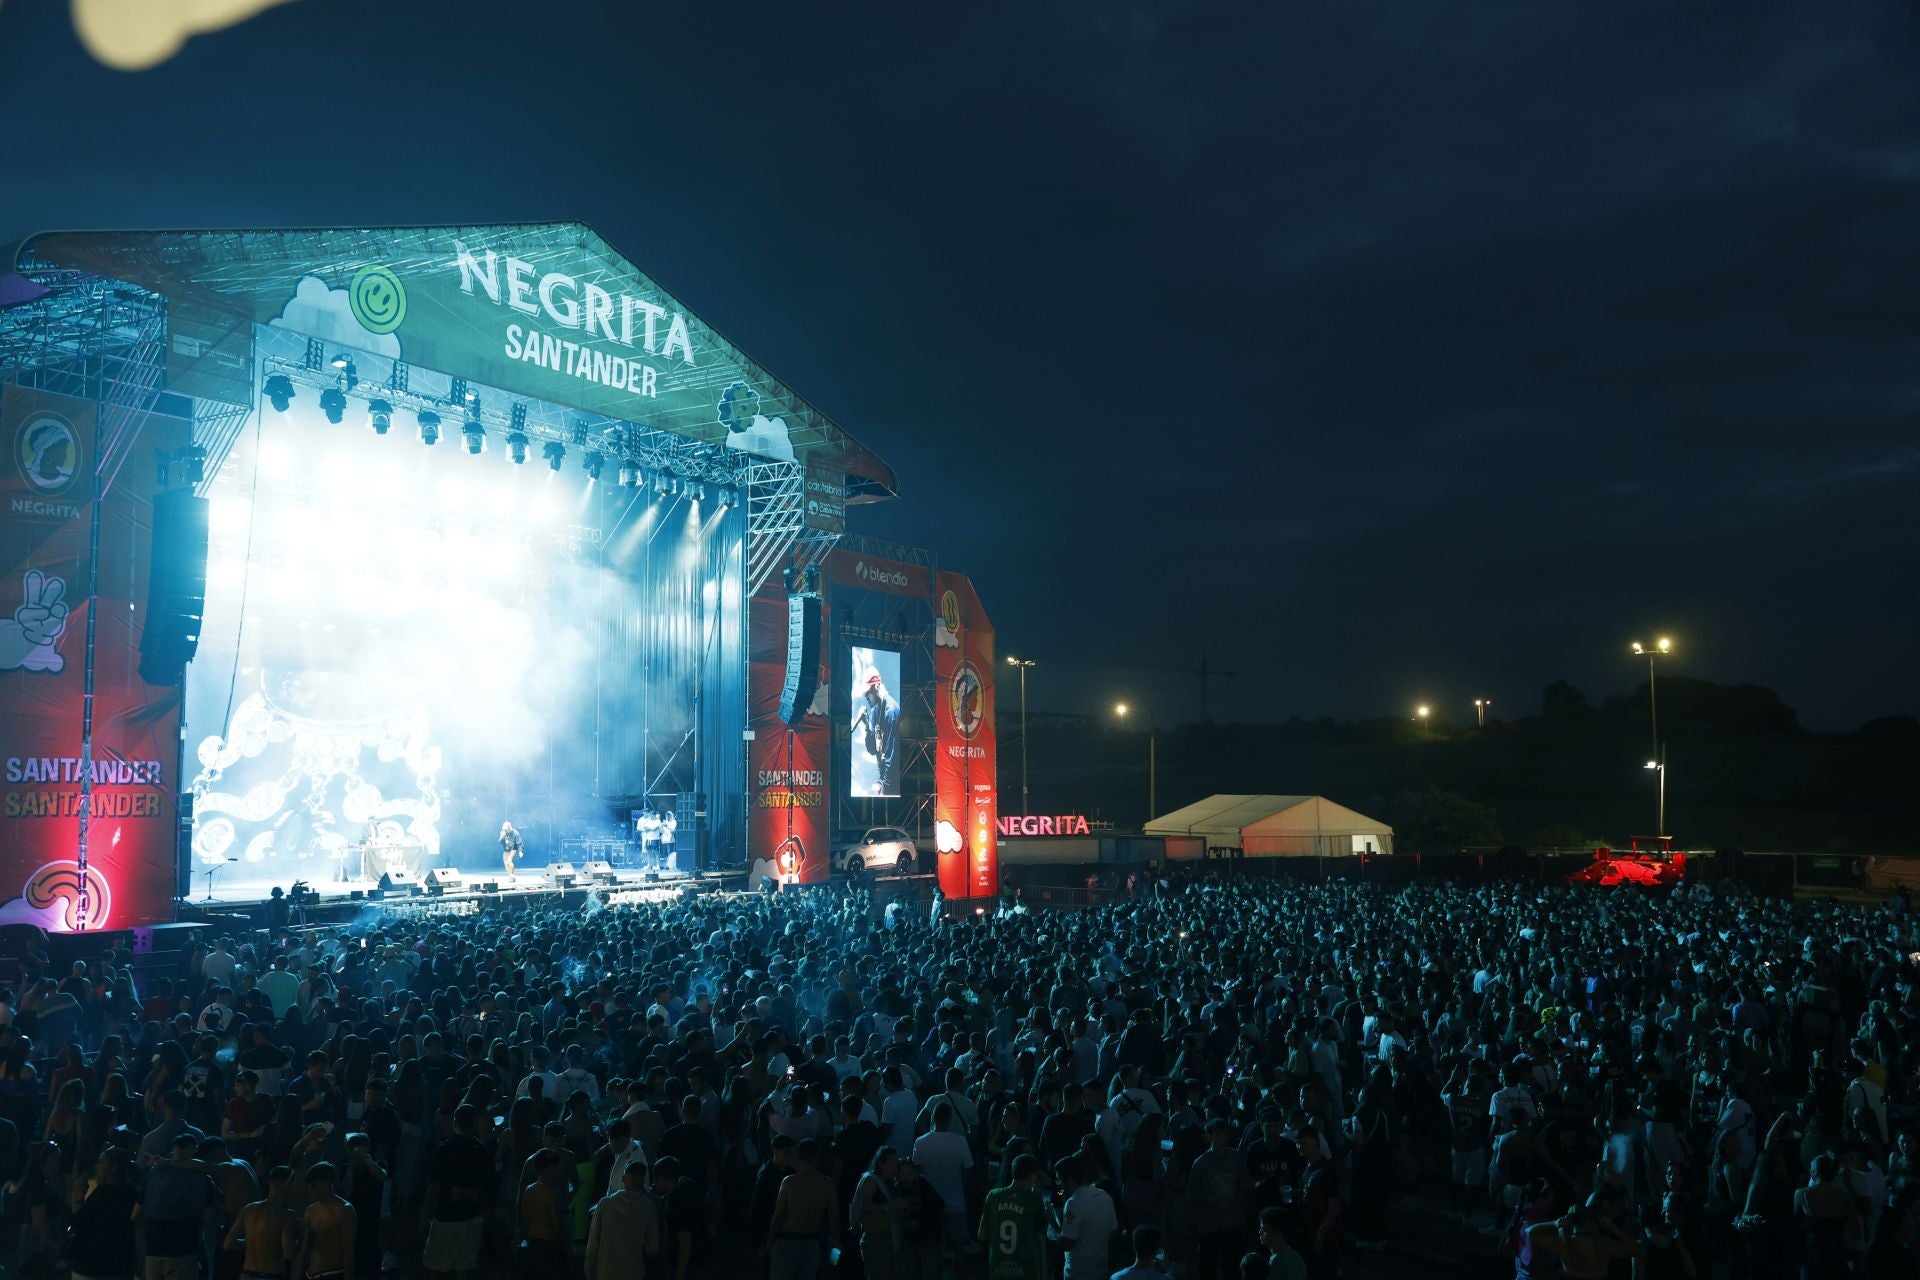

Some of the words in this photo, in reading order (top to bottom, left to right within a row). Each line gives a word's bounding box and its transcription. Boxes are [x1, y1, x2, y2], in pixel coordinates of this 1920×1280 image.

[453, 239, 696, 367] NEGRITA
[505, 324, 656, 398] SANTANDER
[11, 498, 81, 519] NEGRITA
[869, 565, 908, 586] blendio
[948, 745, 986, 759] NEGRITA
[6, 757, 161, 785] SANTANDER
[758, 770, 823, 786] SANTANDER
[4, 791, 161, 818] SANTANDER
[758, 791, 822, 808] SANTANDER
[996, 815, 1090, 836] NEGRITA
[1000, 1219, 1018, 1256] 9
